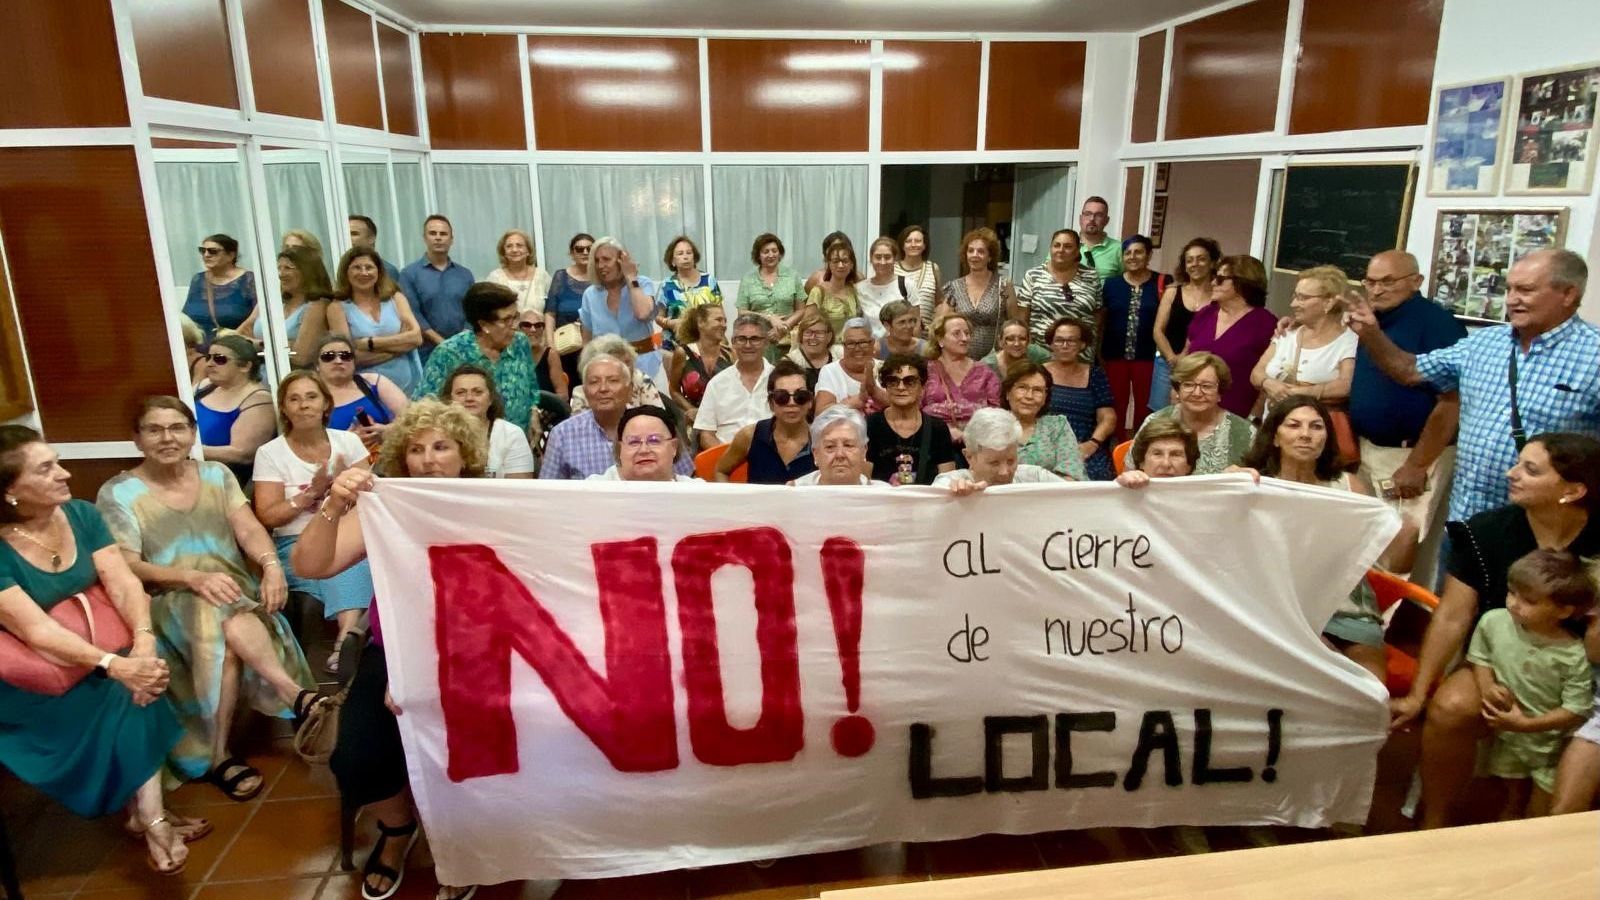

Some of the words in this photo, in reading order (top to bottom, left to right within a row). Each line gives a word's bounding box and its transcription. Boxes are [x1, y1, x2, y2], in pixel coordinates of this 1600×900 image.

[1042, 528, 1154, 571] cierre
[428, 526, 875, 782] NO!
[947, 613, 989, 663] de
[1045, 592, 1183, 656] nuestro
[909, 708, 1283, 799] LOCAL!
